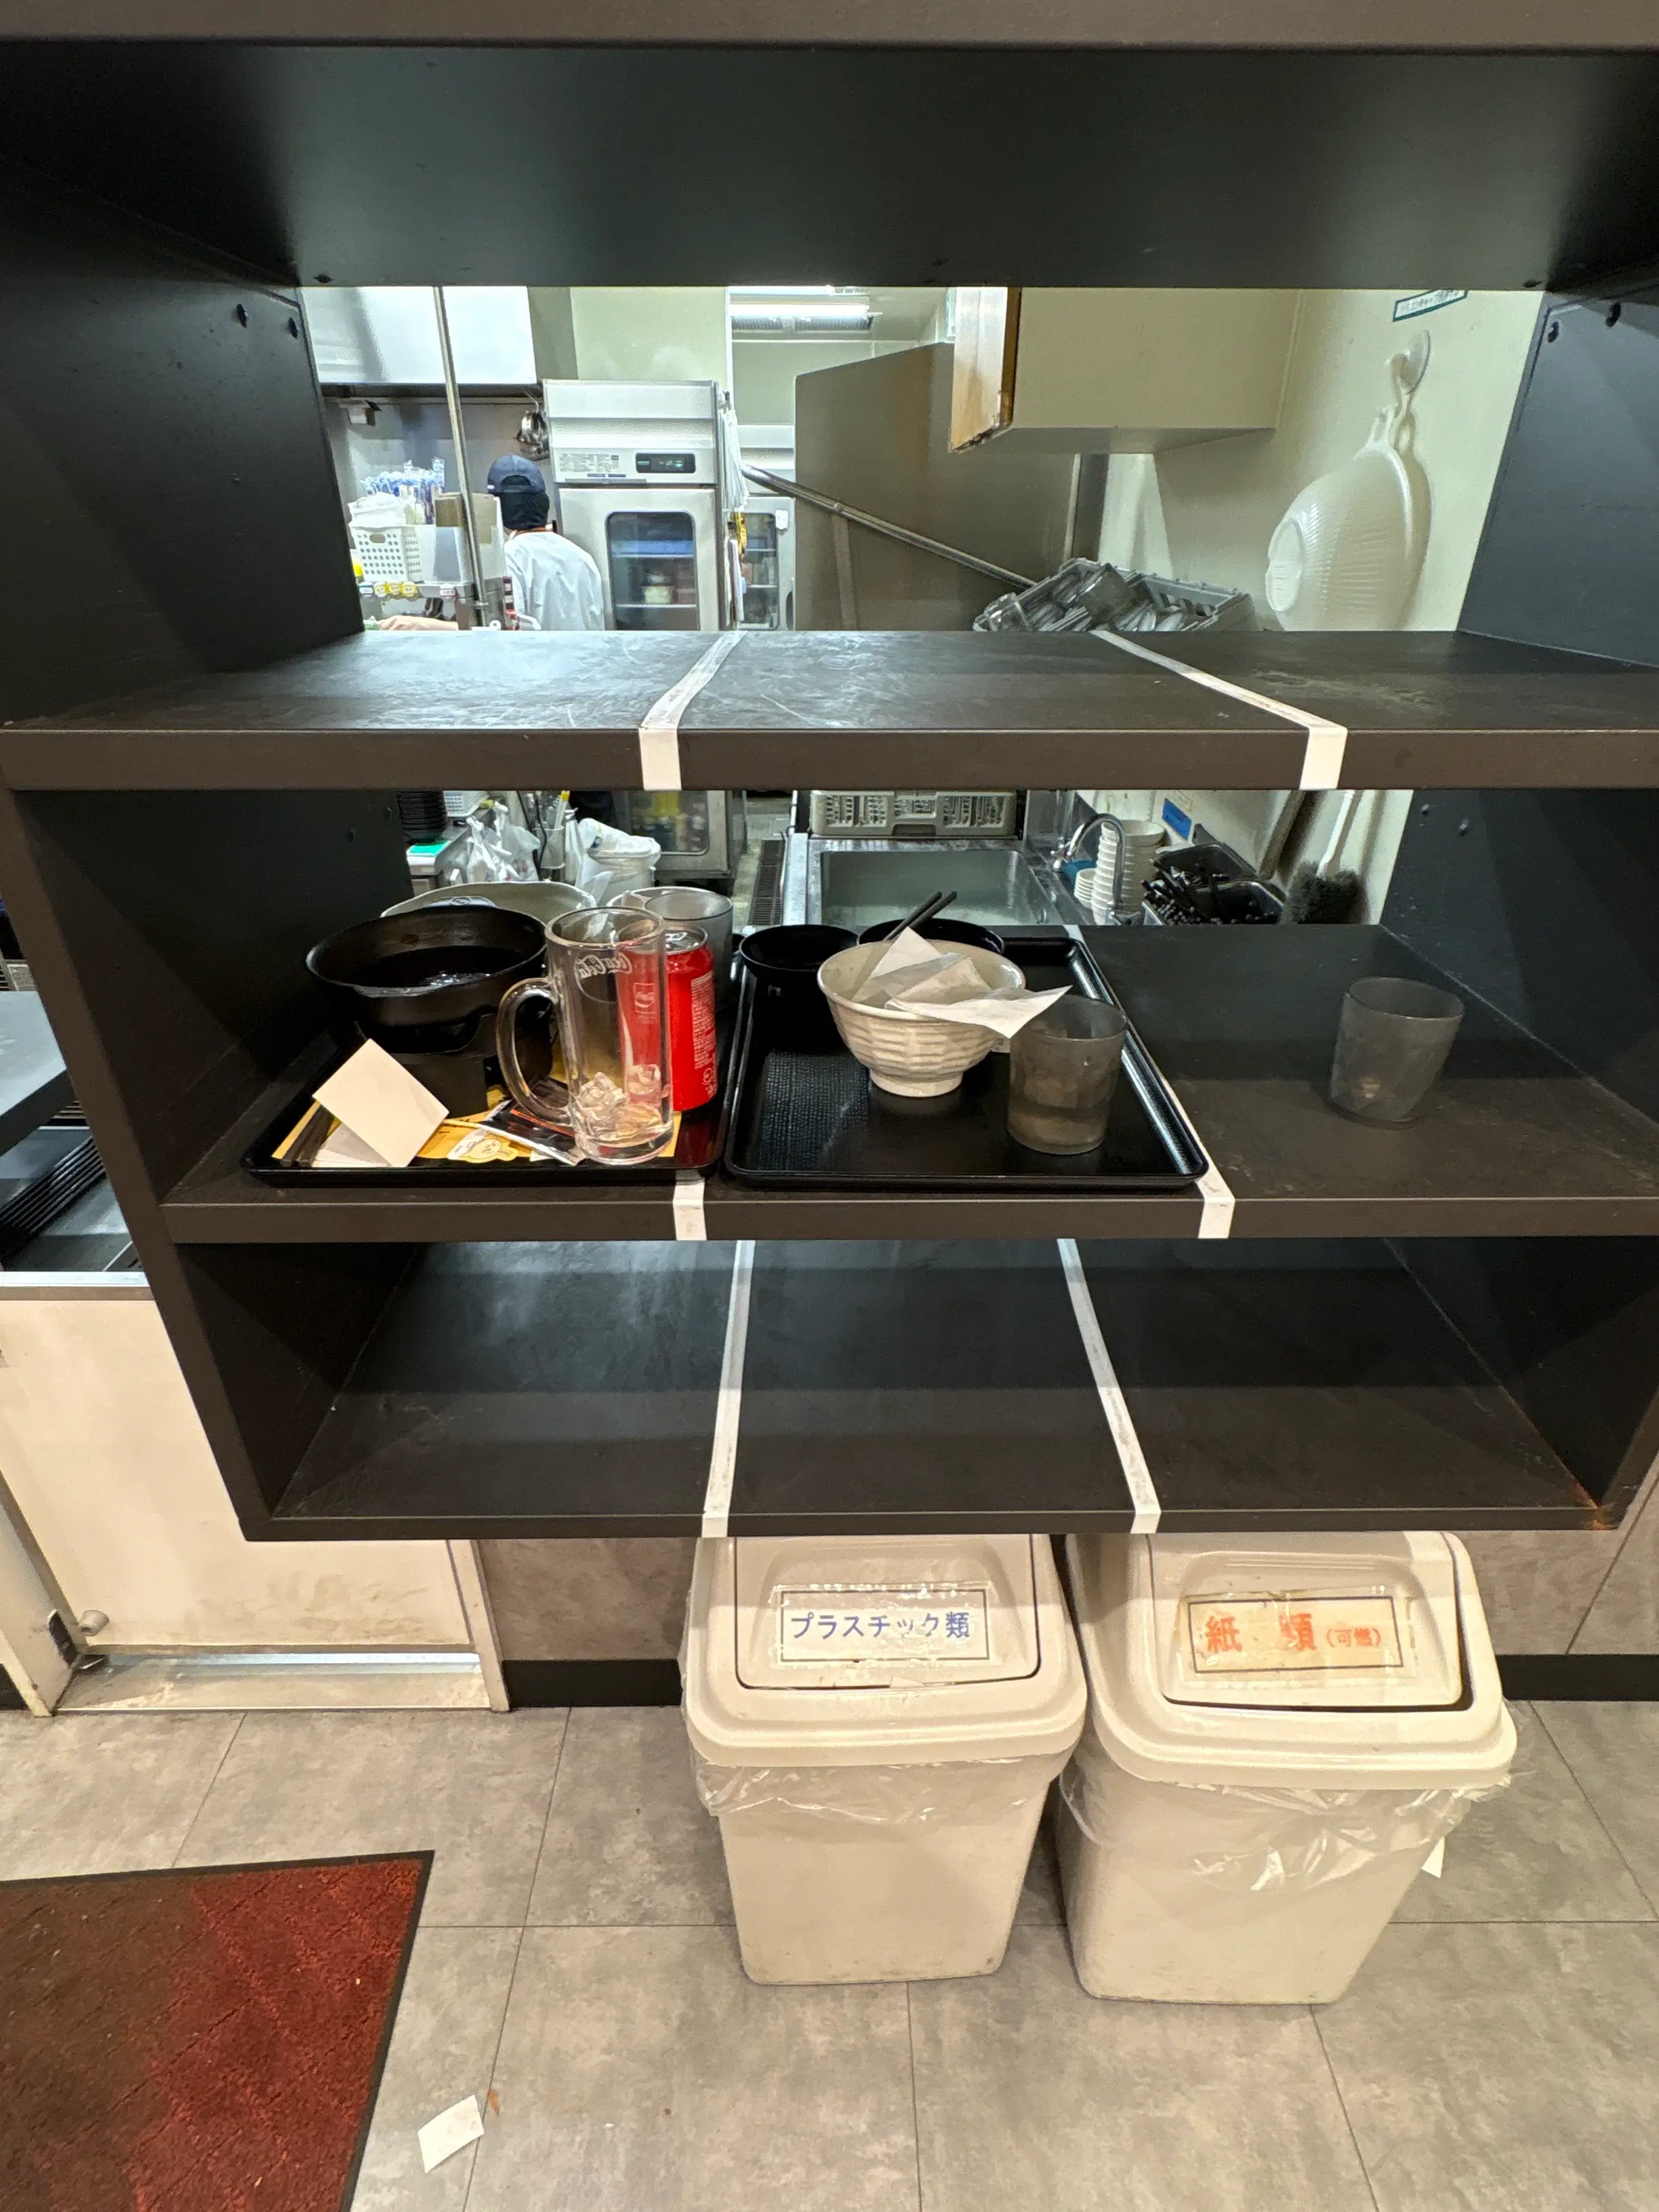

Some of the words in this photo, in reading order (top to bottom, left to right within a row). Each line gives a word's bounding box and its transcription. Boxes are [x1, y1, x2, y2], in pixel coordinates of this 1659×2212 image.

[791, 1611, 970, 1640] プラスチック類
